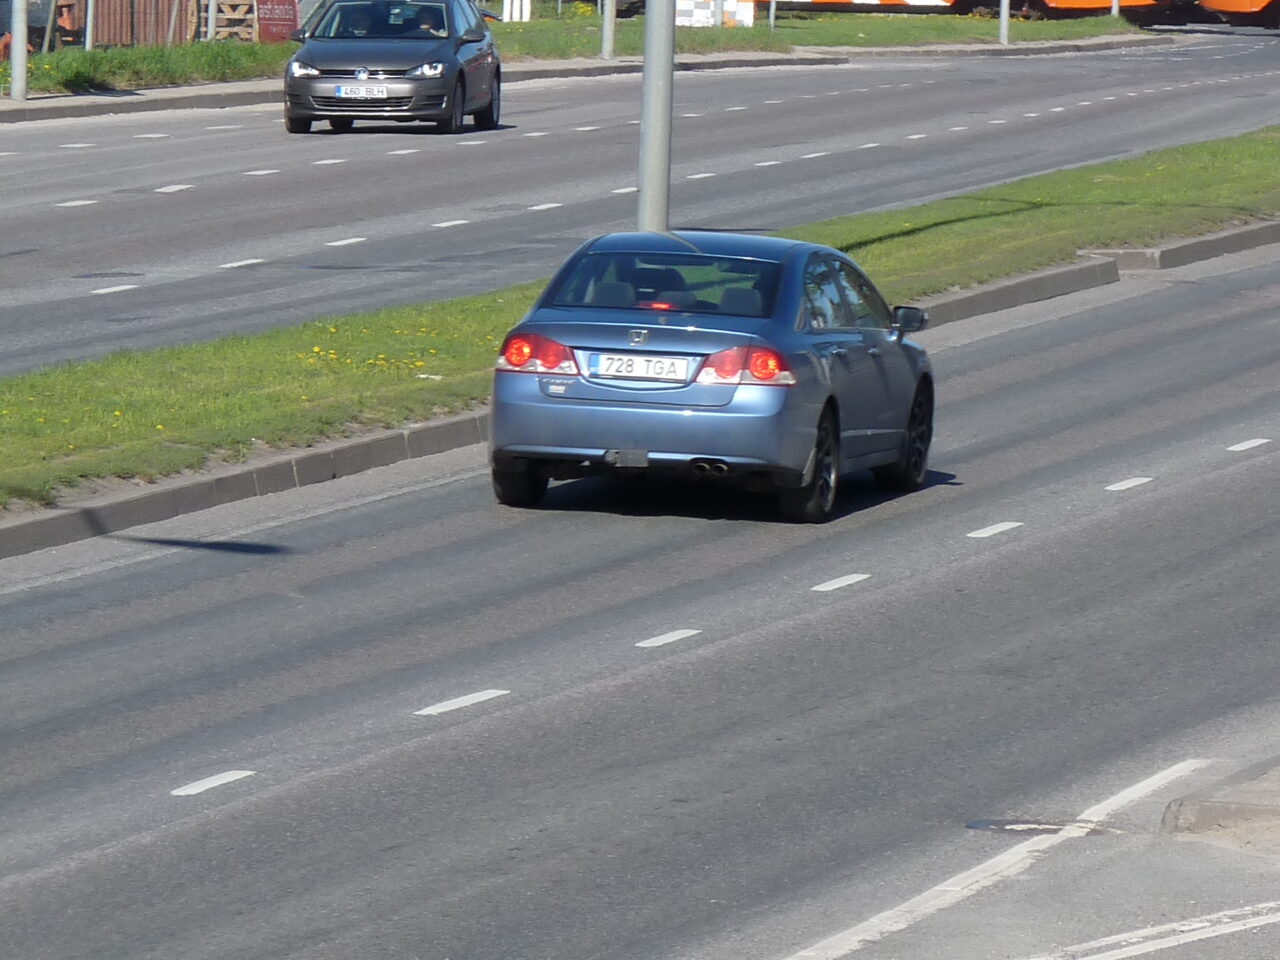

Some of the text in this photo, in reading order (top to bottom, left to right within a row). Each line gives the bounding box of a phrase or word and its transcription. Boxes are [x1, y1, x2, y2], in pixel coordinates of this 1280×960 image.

[343, 87, 360, 96] 460
[605, 358, 678, 377] 728 TGA
